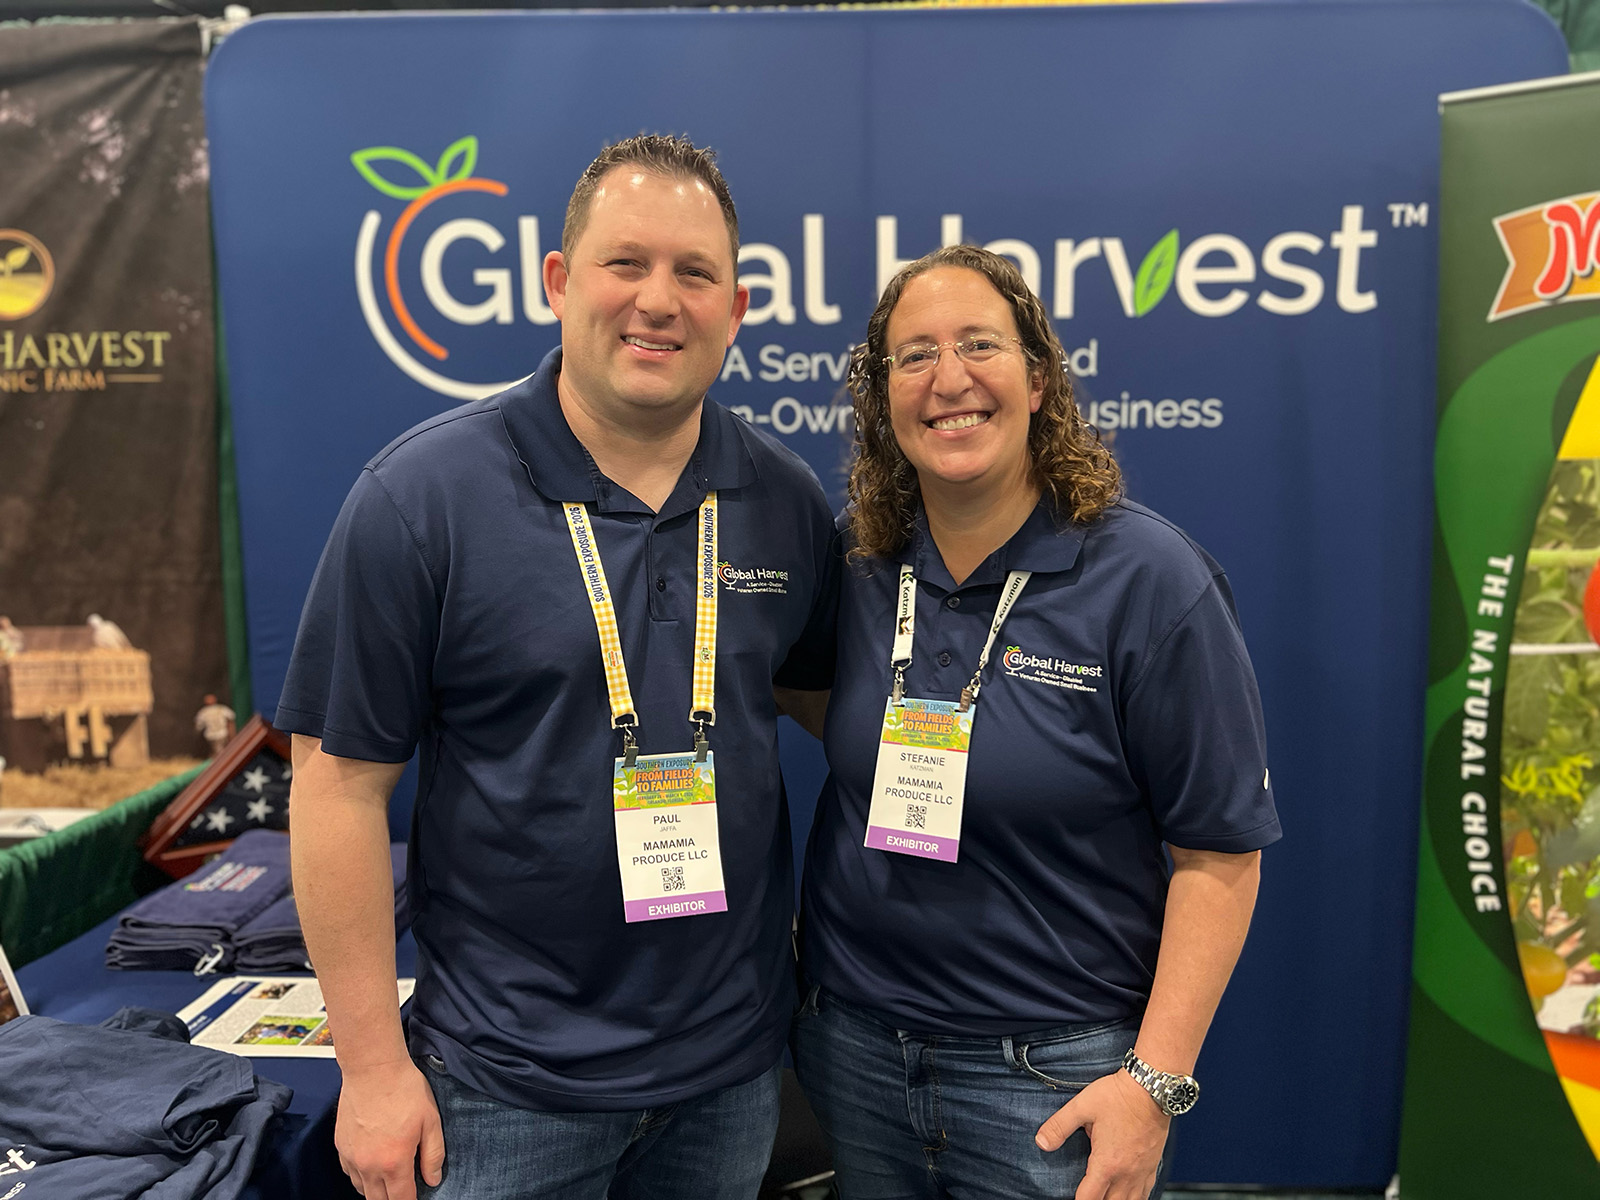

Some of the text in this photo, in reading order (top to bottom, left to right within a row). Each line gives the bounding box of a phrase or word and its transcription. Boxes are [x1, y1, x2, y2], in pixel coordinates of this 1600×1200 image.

[421, 214, 842, 326] Glal
[1387, 202, 1429, 228] TM
[720, 344, 753, 382] A
[44, 368, 106, 392] FARM
[704, 507, 714, 543] SOUTHERN
[569, 506, 605, 602] SOUTHERN EXPOSURE 2026
[704, 544, 713, 580] EXPOSURE
[723, 567, 788, 581] Global Harves
[902, 586, 910, 616] Katzm
[999, 577, 1022, 618] Katzman
[1010, 653, 1103, 677] Global Harvest
[904, 711, 954, 724] FROM FIELDS
[903, 720, 952, 734] TO FAMILIES
[1461, 554, 1514, 913] THE NATURAL CHOICE
[900, 752, 945, 766] STEFANIE
[636, 769, 693, 782] FROM FIELDS
[897, 776, 943, 790] MAMAMIA
[637, 779, 693, 792] TO FAMILIES
[885, 787, 953, 805] PRODUCE LLC
[653, 814, 681, 825] PAUL
[643, 837, 695, 851] MAMAMIA
[886, 835, 939, 853] EXHIBITOR
[632, 849, 708, 865] PRODUCE LLC
[648, 900, 706, 916] EXHIBITOR
